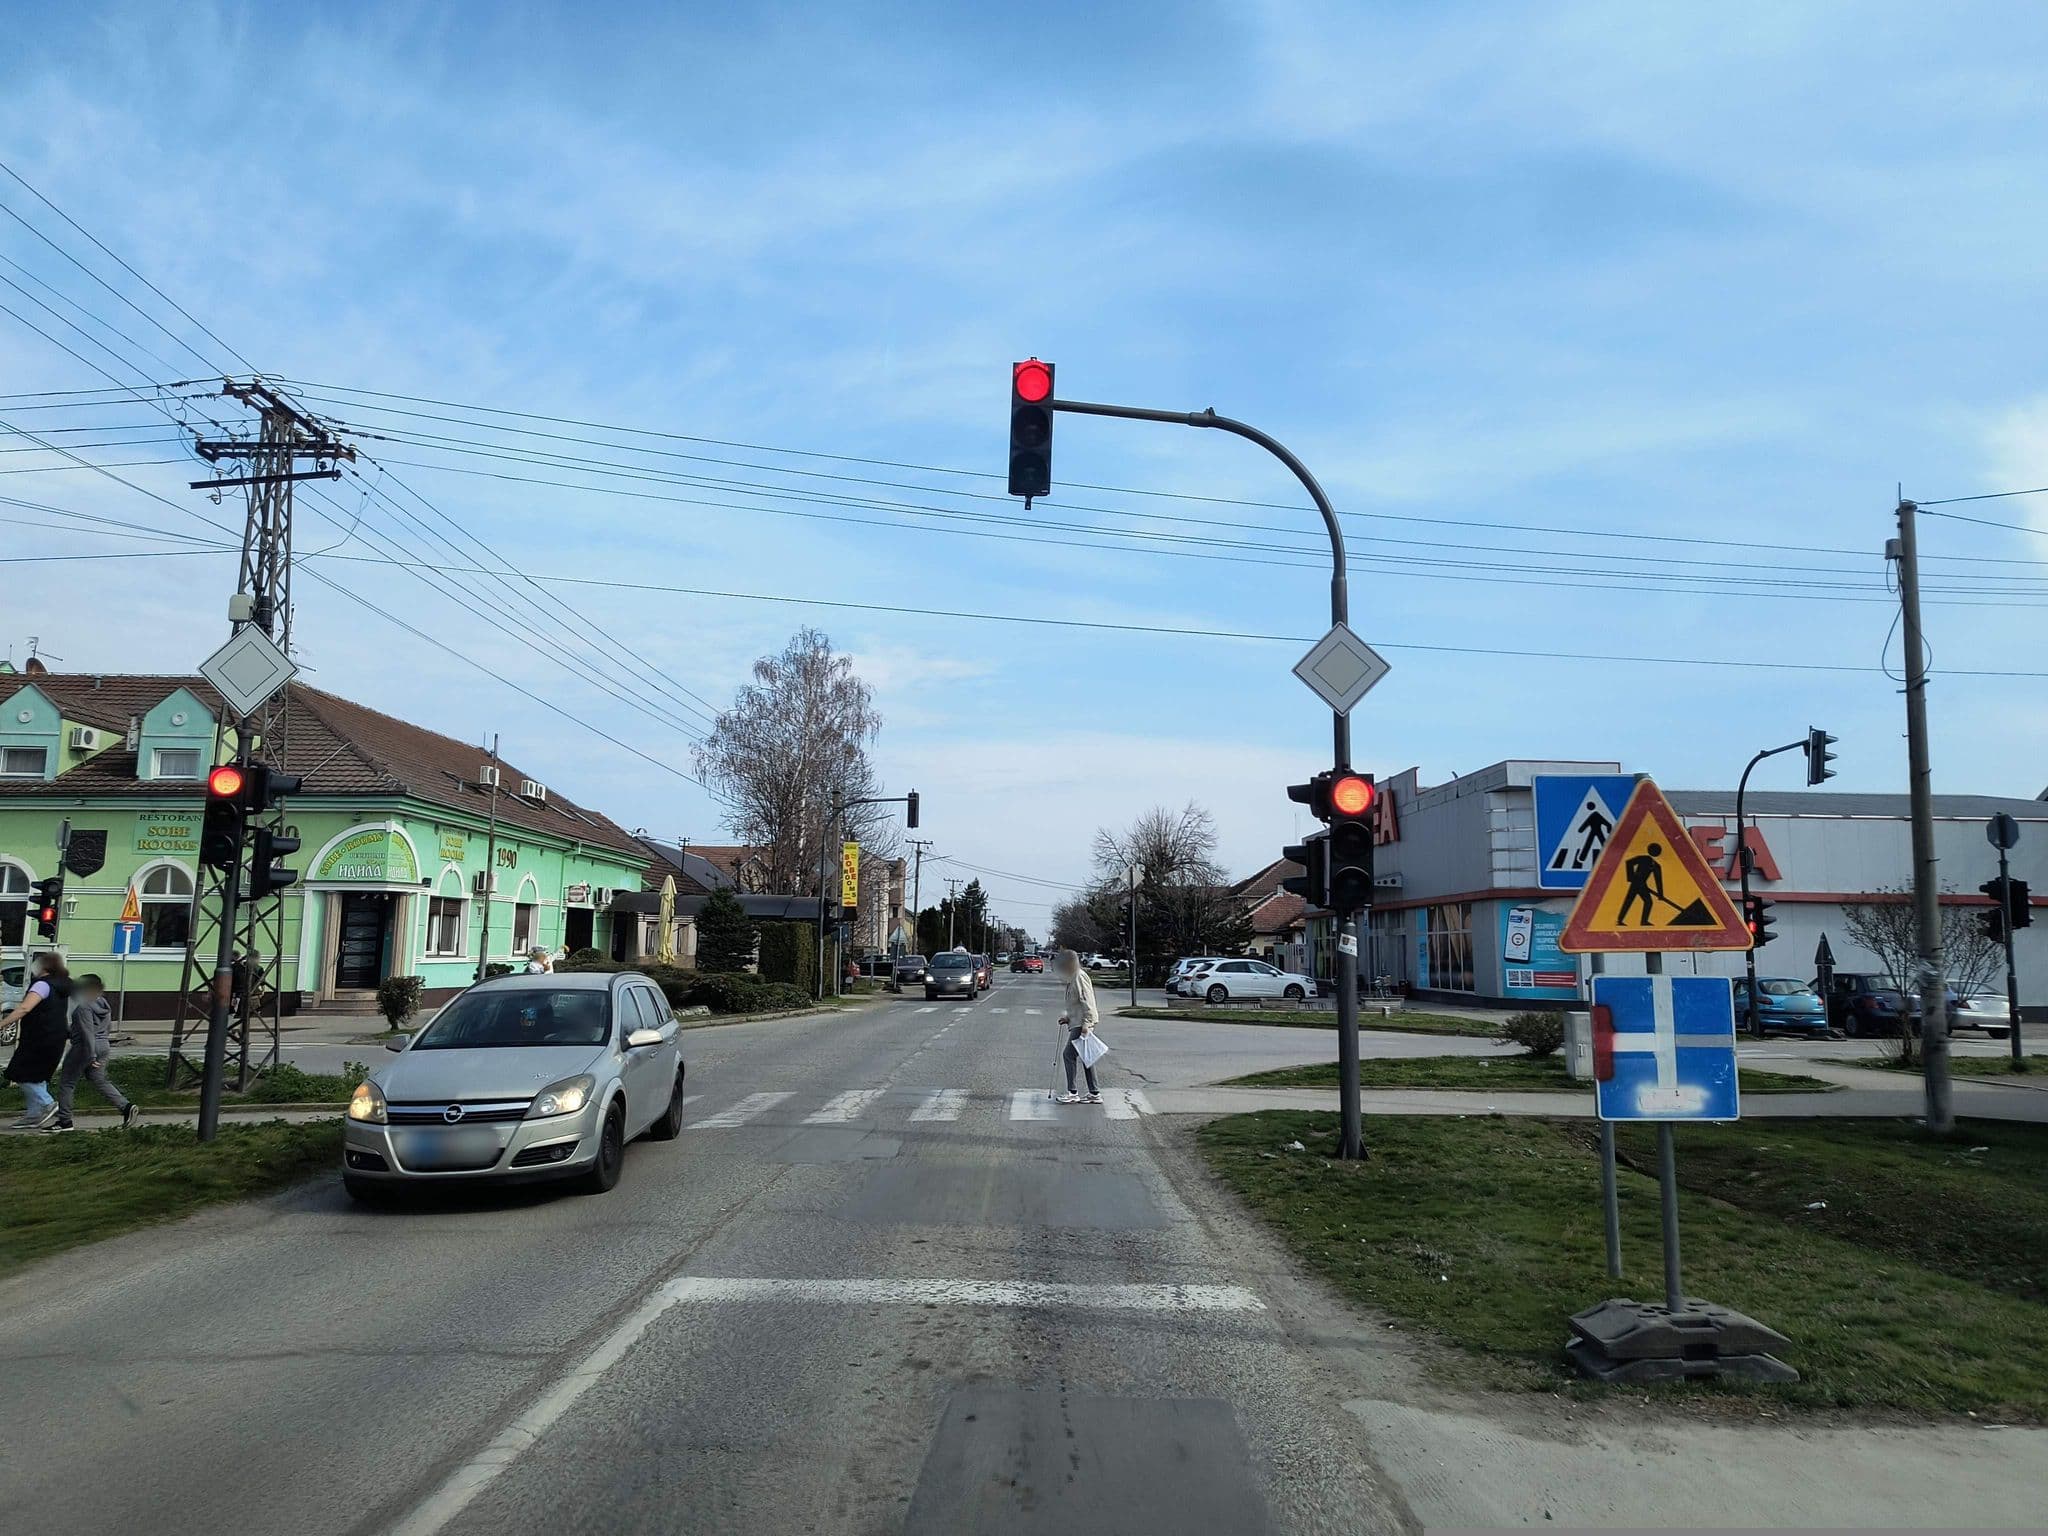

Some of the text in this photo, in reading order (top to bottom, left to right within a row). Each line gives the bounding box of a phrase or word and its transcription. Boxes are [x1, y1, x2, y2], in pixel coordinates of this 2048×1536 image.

[139, 814, 202, 822] RESTORAN
[147, 826, 189, 838] SOBE
[138, 839, 198, 851] ROOMS
[345, 832, 384, 852] ROOMS
[496, 847, 517, 870] 1990
